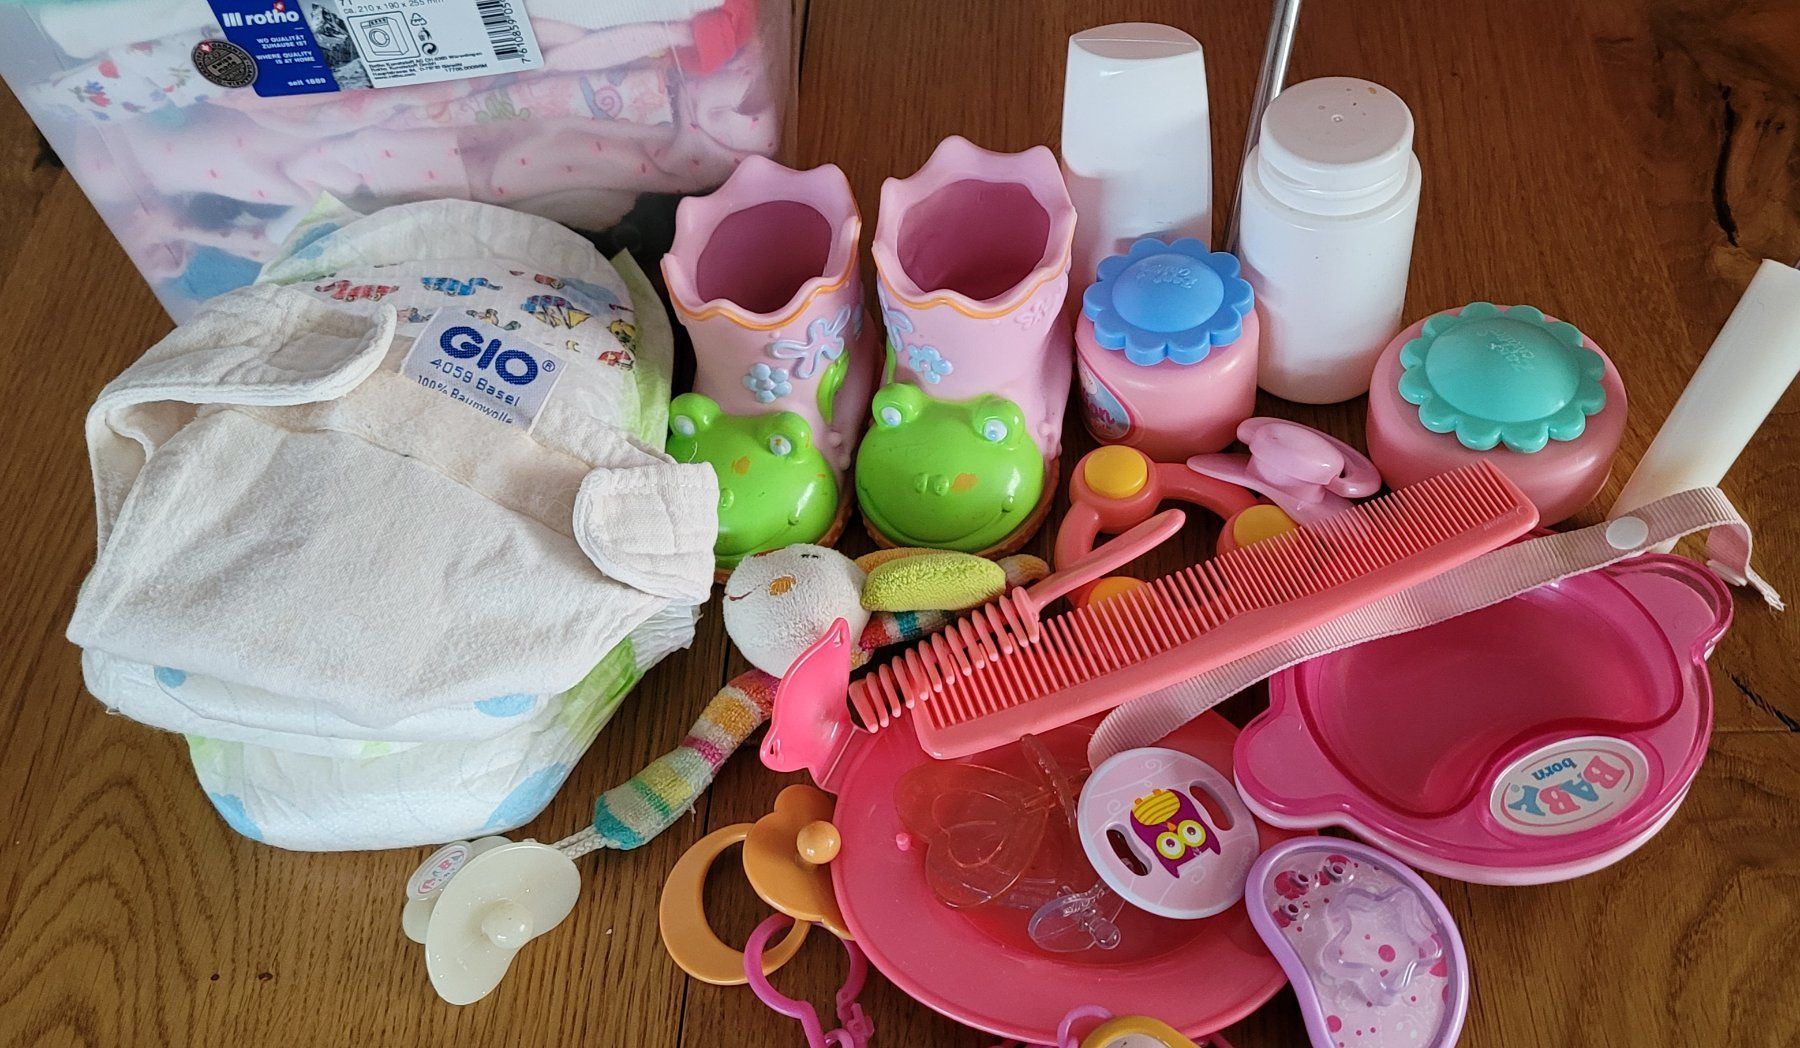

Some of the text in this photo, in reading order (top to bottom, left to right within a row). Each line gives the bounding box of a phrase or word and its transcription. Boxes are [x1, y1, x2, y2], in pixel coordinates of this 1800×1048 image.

[245, 9, 299, 26] rotho
[358, 4, 375, 13] 210
[270, 34, 305, 42] QUALITÄT
[288, 77, 326, 87] seit 1889
[417, 374, 447, 395] 100%
[475, 377, 521, 408] Basel
[1531, 757, 1578, 781] born
[1507, 754, 1625, 817] BABY
